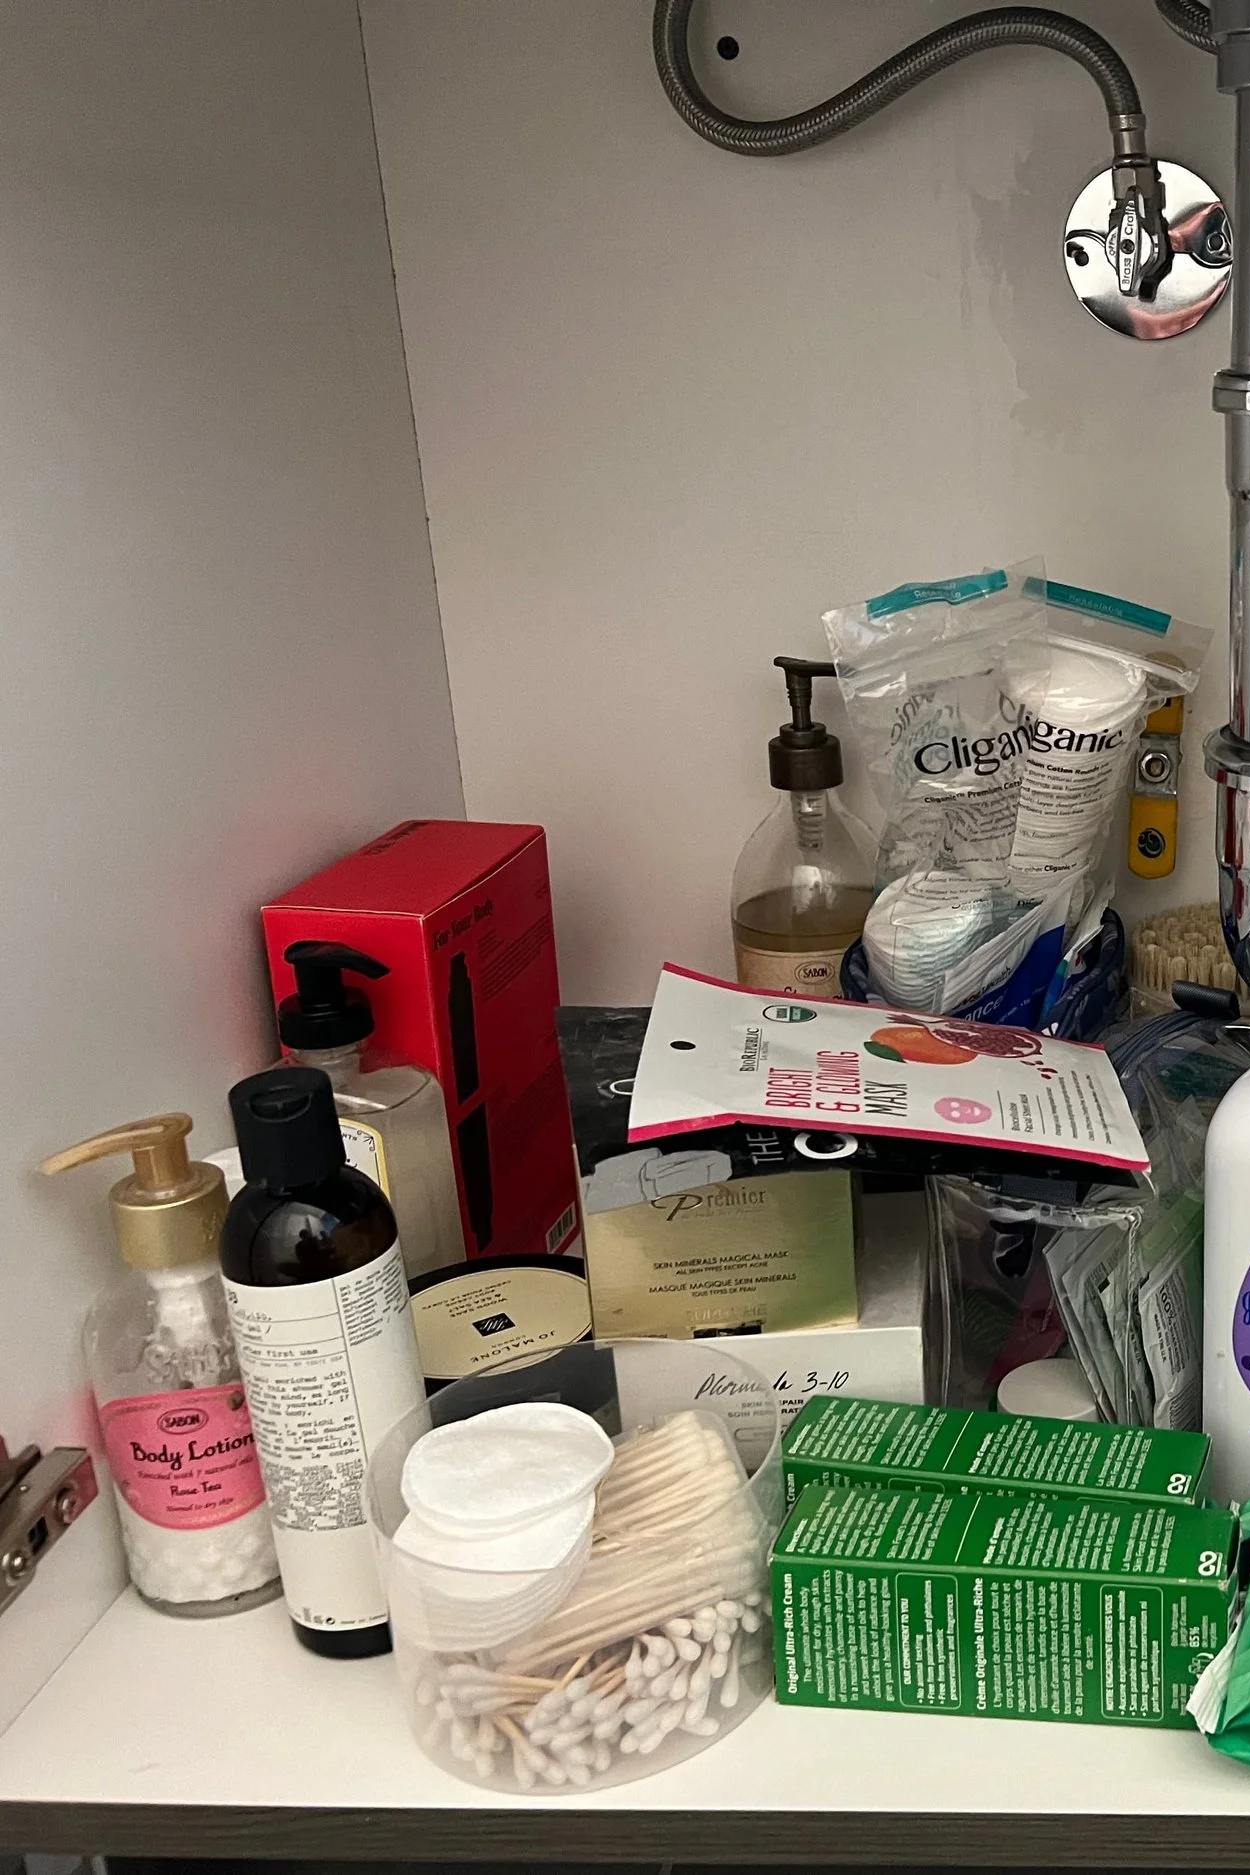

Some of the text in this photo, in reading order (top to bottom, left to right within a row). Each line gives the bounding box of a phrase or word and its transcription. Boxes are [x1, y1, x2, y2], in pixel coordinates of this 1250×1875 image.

[1121, 257, 1132, 285] Brass
[801, 965, 829, 979] SABON
[765, 1067, 813, 1109] BRIGHT
[815, 1050, 861, 1113] & GLOWING
[863, 1080, 908, 1118] MASK
[745, 1131, 785, 1166] THE
[650, 1187, 767, 1222] Premier
[653, 1250, 789, 1271] SKIN MINERALS MAGICAL MASK
[649, 1272, 797, 1294] MASQUE MAGIQUE SKIN MINERALS
[266, 1349, 293, 1358] first
[469, 1330, 556, 1364] JO MALONE
[801, 1370, 850, 1393] 3-10
[163, 1413, 200, 1429] SABON
[129, 1432, 255, 1471] Body Lotion
[170, 1480, 222, 1498] Rose Tea
[900, 1598, 909, 1613] YOU
[783, 1573, 799, 1694] Original Ultra-Rich Cream
[973, 1577, 987, 1710] Crème Originale Ultra-Riche
[903, 1669, 912, 1685] OUR
